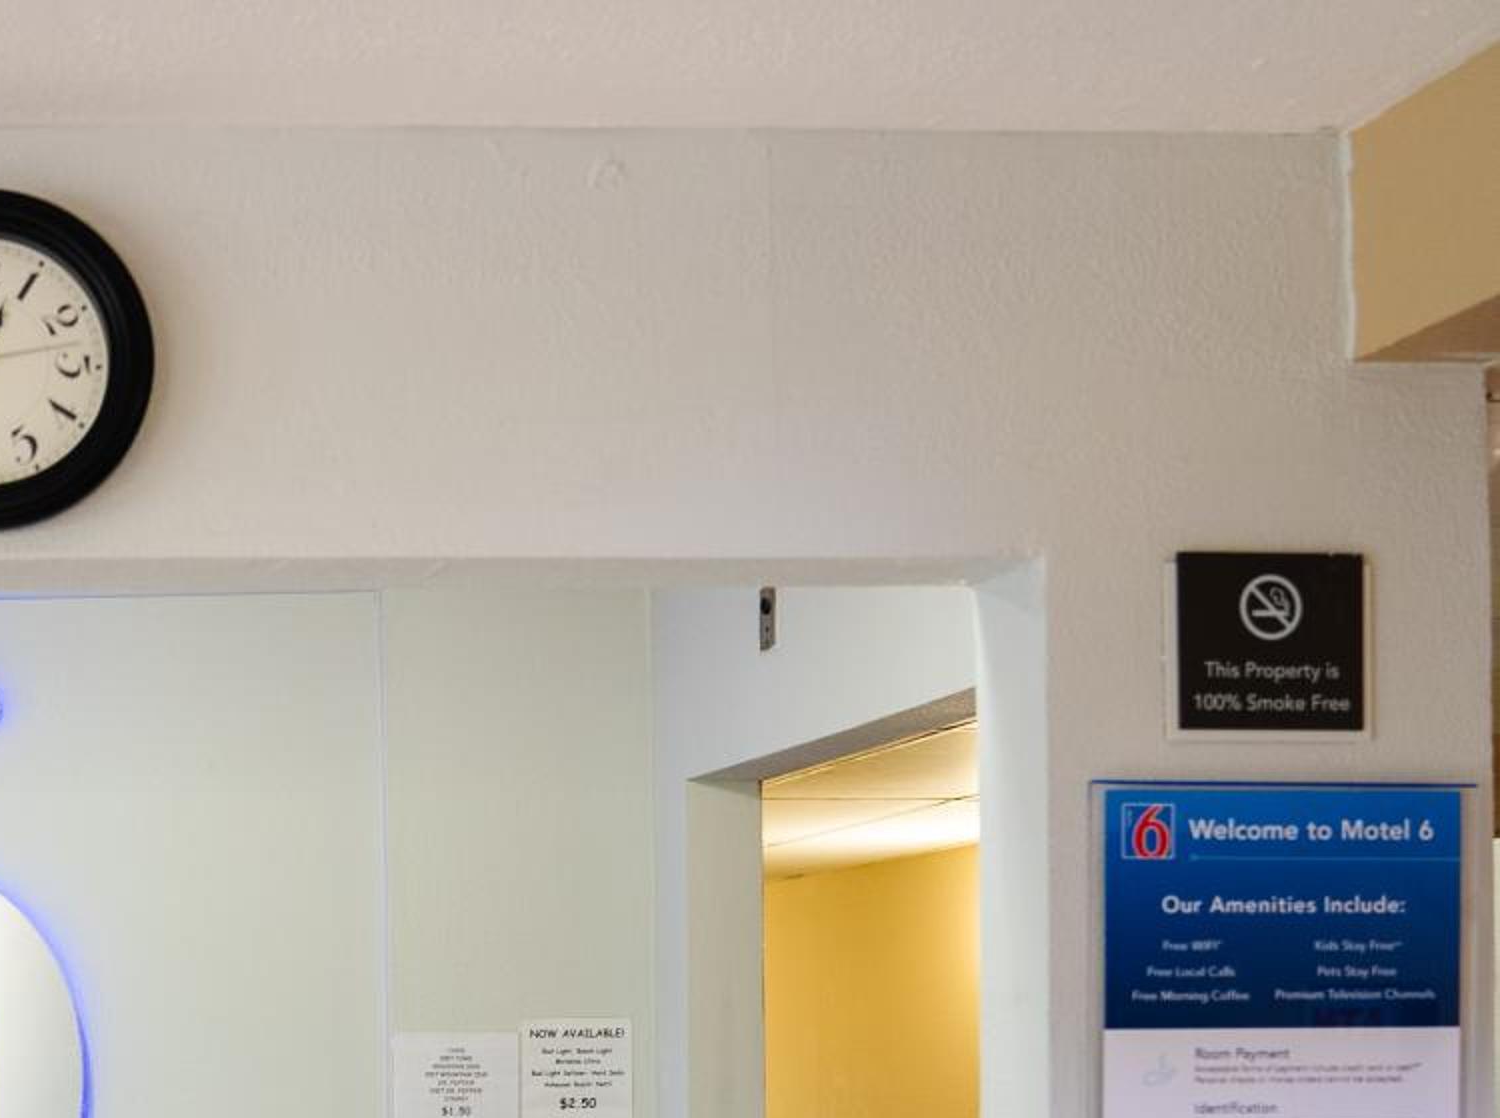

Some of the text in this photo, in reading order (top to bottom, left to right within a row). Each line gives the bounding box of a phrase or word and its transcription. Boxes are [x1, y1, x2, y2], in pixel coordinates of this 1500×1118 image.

[17, 272, 39, 301] 1
[42, 303, 79, 335] 2
[1204, 661, 1340, 684] This Property is
[1194, 693, 1350, 711] 100% Smoke Free
[1131, 804, 1171, 860] 6
[1188, 818, 1434, 841] Welcome to Motel 6
[1161, 895, 1406, 915] Our Amenities Include:
[1132, 990, 1250, 1004] Free Morning Coffee
[1274, 989, 1436, 1000] Premium Television Channels
[530, 1028, 625, 1038] NOW AVAILABLE!
[442, 1106, 471, 1117] $1.50
[560, 1097, 596, 1109] $2.50
[1194, 1102, 1278, 1114] Identification
